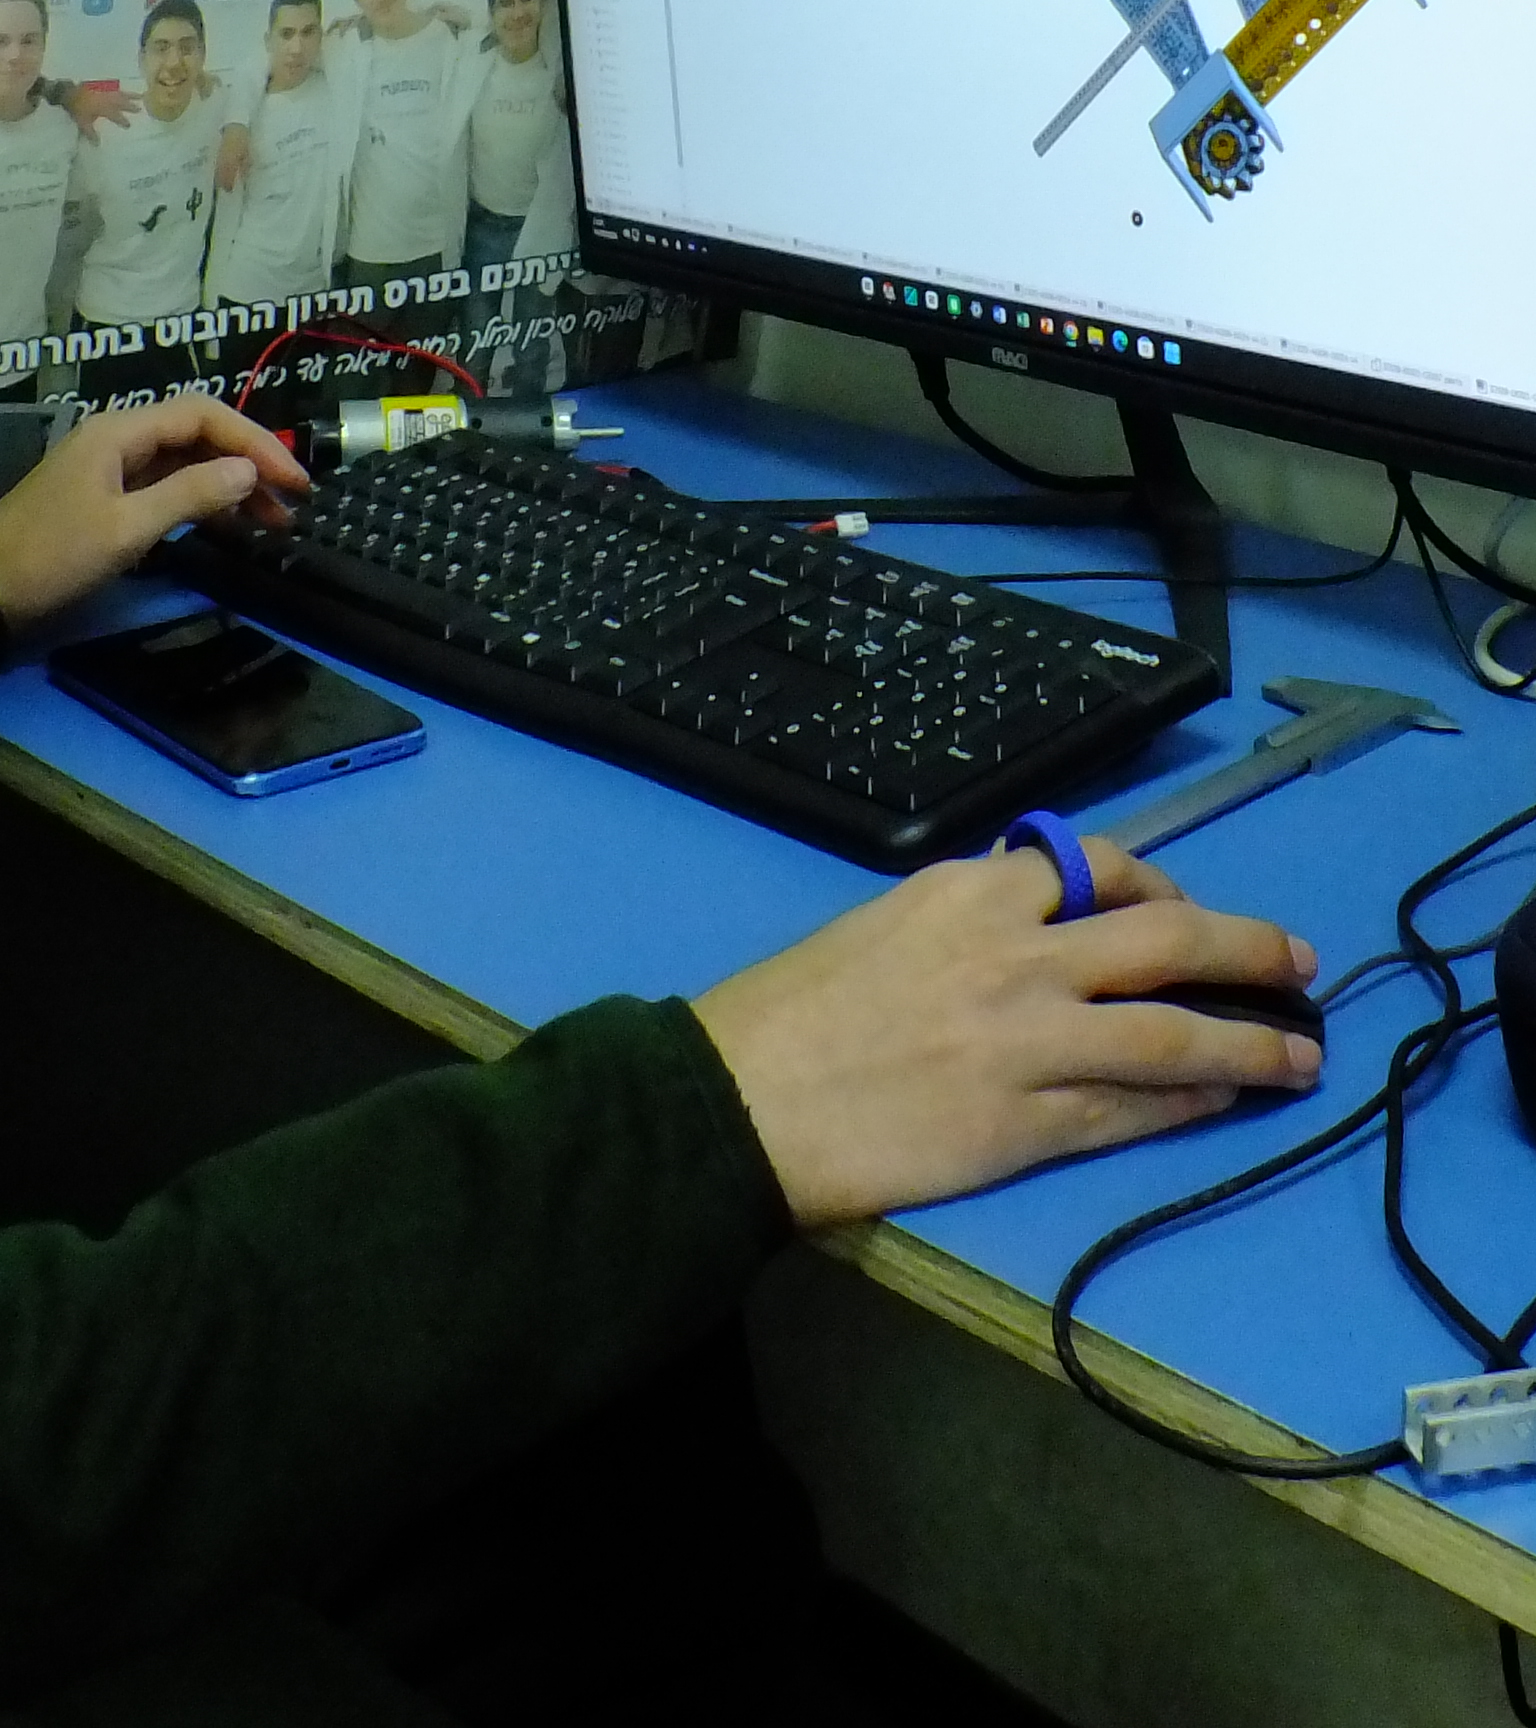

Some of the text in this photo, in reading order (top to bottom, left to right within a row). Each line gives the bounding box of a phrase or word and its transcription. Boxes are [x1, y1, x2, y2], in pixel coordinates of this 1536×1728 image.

[384, 267, 472, 309] בפרס
[155, 300, 276, 348] הרובוט
[296, 353, 330, 383] עד
